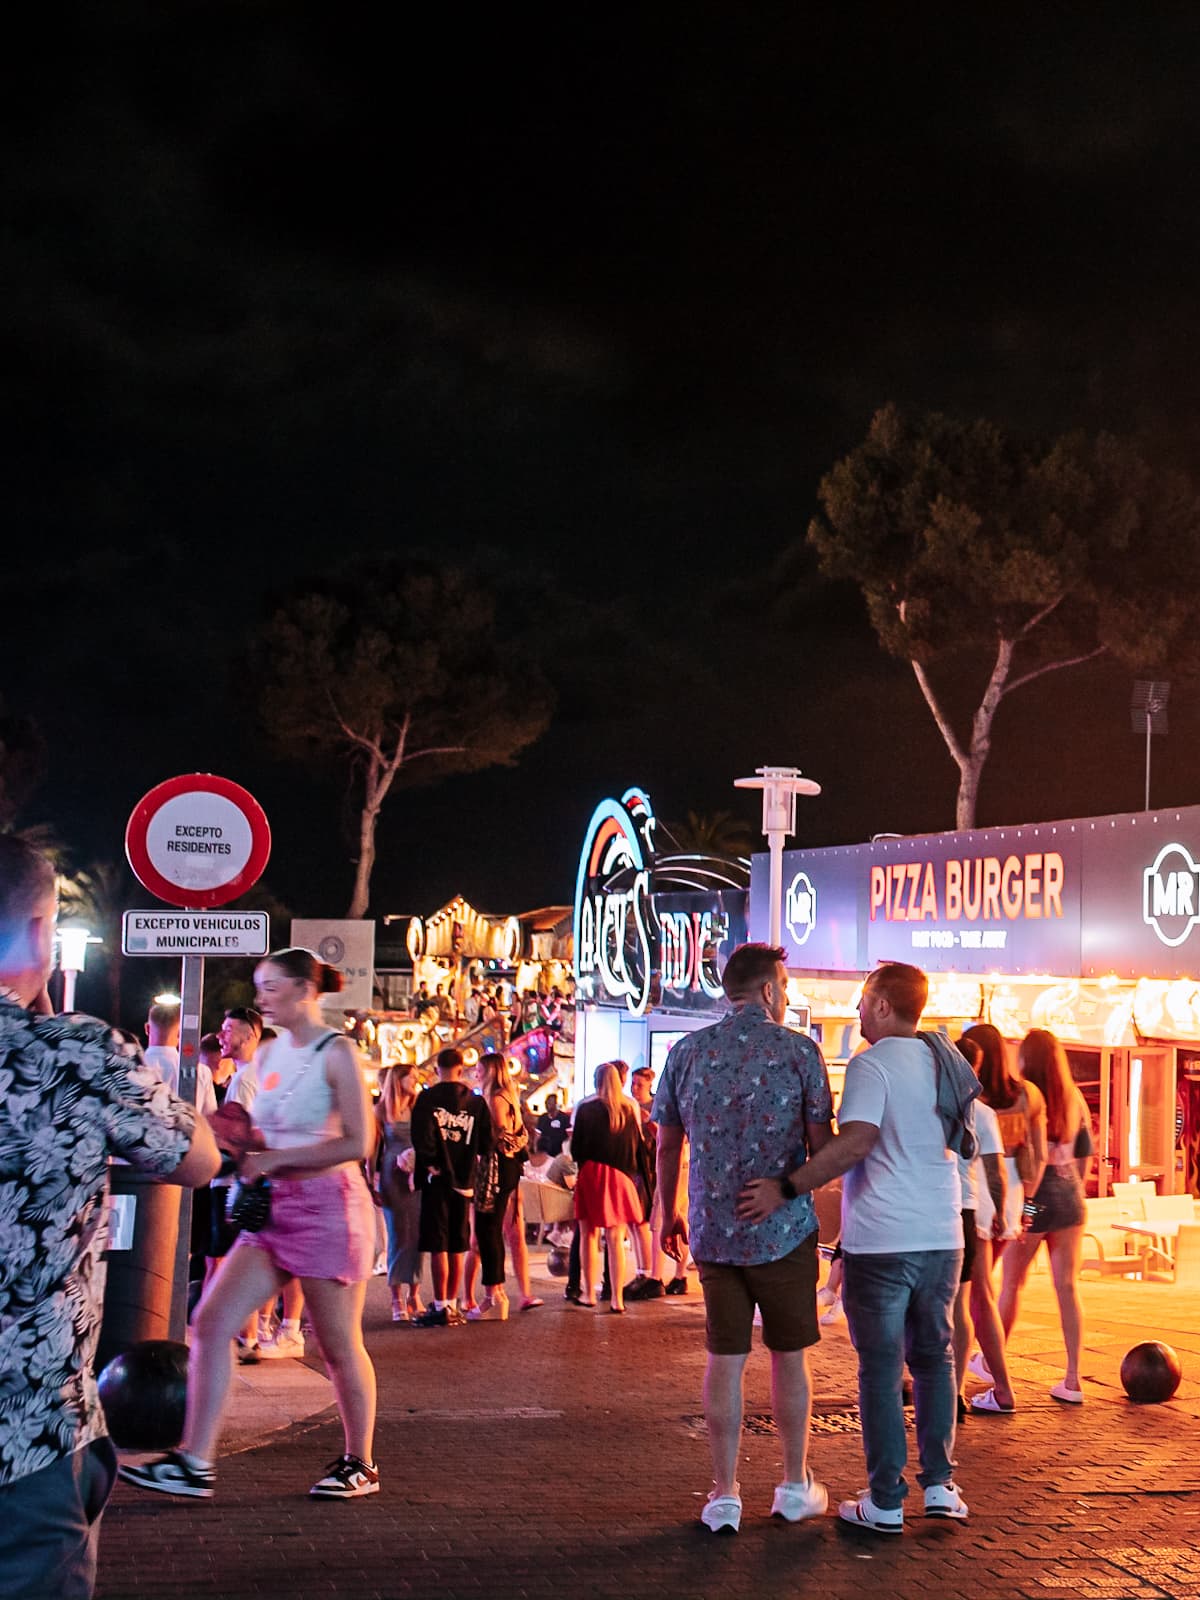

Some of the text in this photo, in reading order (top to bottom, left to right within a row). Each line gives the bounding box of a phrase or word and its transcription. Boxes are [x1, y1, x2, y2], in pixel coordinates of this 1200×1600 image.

[175, 825, 223, 839] EXCEPTO
[167, 841, 232, 855] RESIDENTES
[869, 852, 1065, 922] PIZZA BURGER
[1153, 871, 1194, 916] MR
[135, 918, 260, 930] EXCEPTO VEHICULOS
[156, 936, 239, 947] MUNICIPALES
